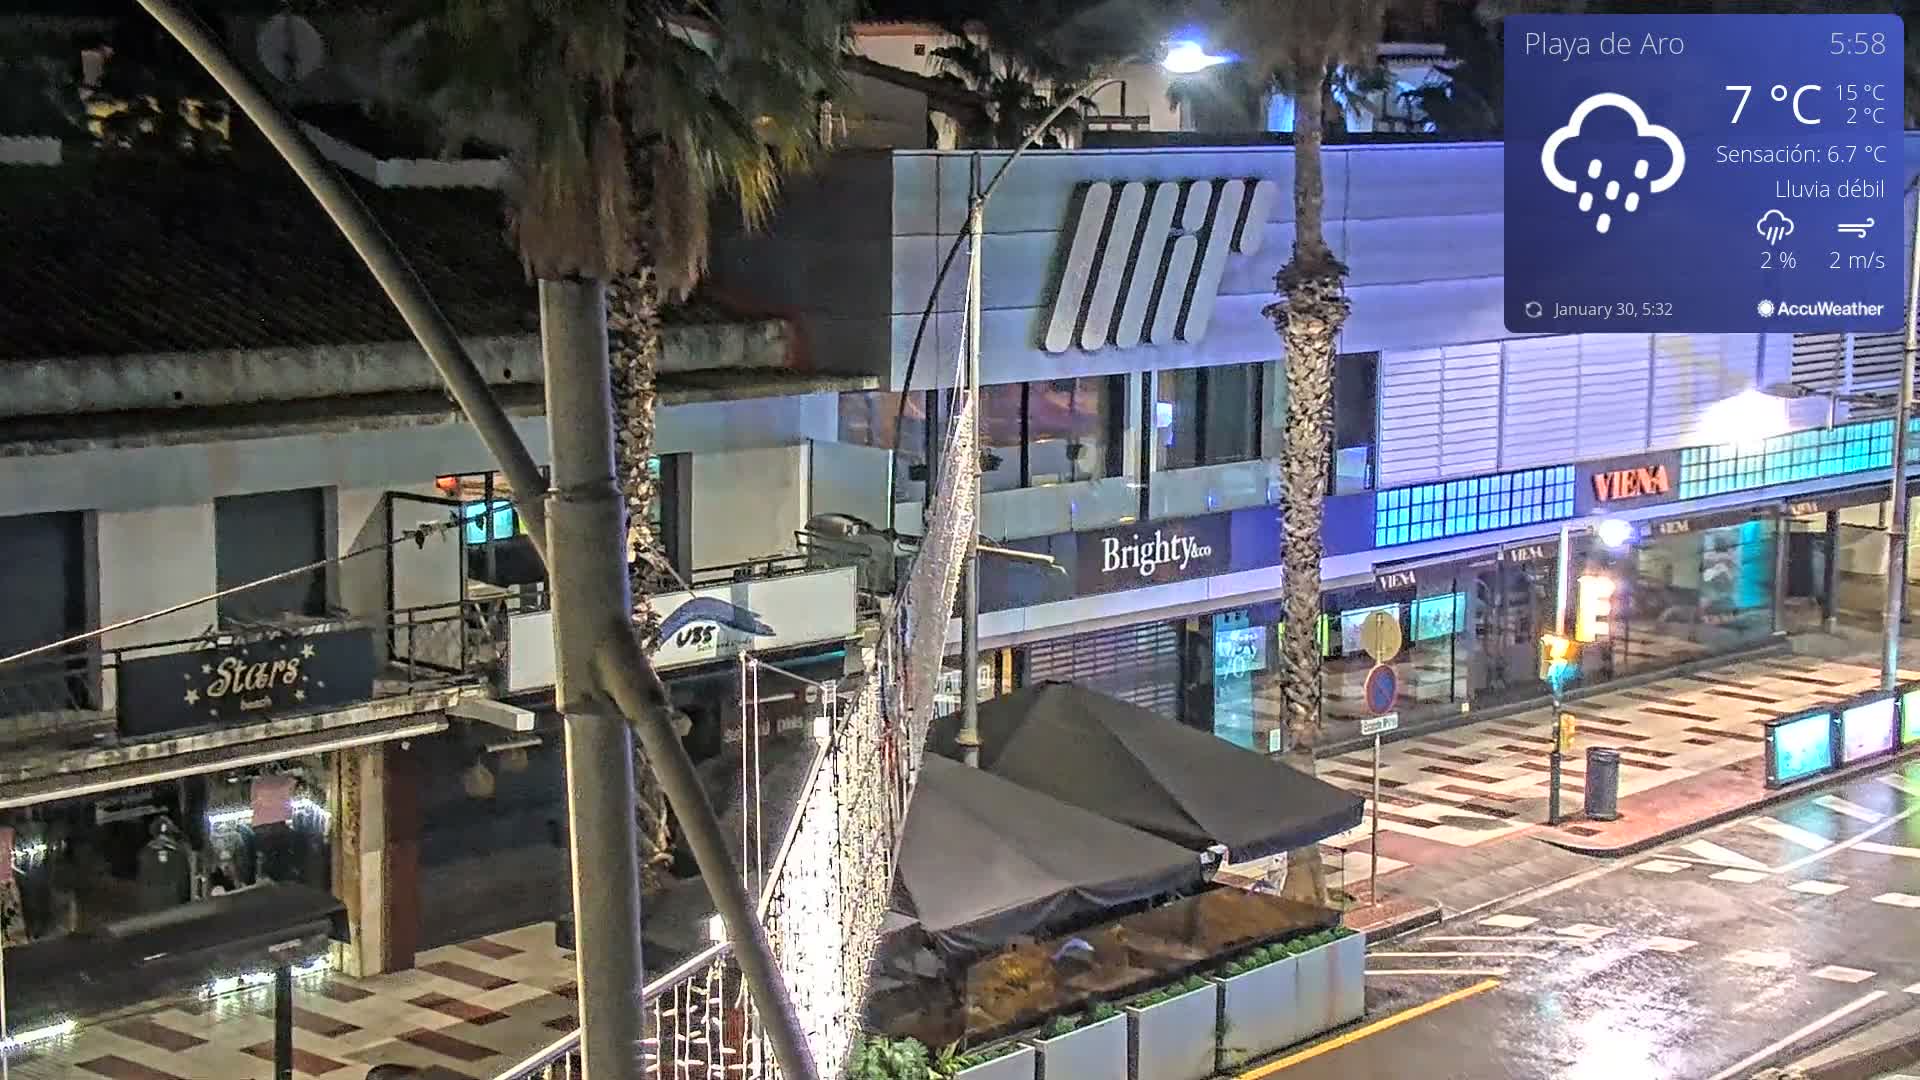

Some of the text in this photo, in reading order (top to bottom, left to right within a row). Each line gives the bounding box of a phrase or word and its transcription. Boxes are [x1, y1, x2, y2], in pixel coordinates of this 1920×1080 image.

[1592, 465, 1669, 502] VIENA
[1379, 570, 1416, 589] VIENA
[206, 656, 300, 697] Stars
